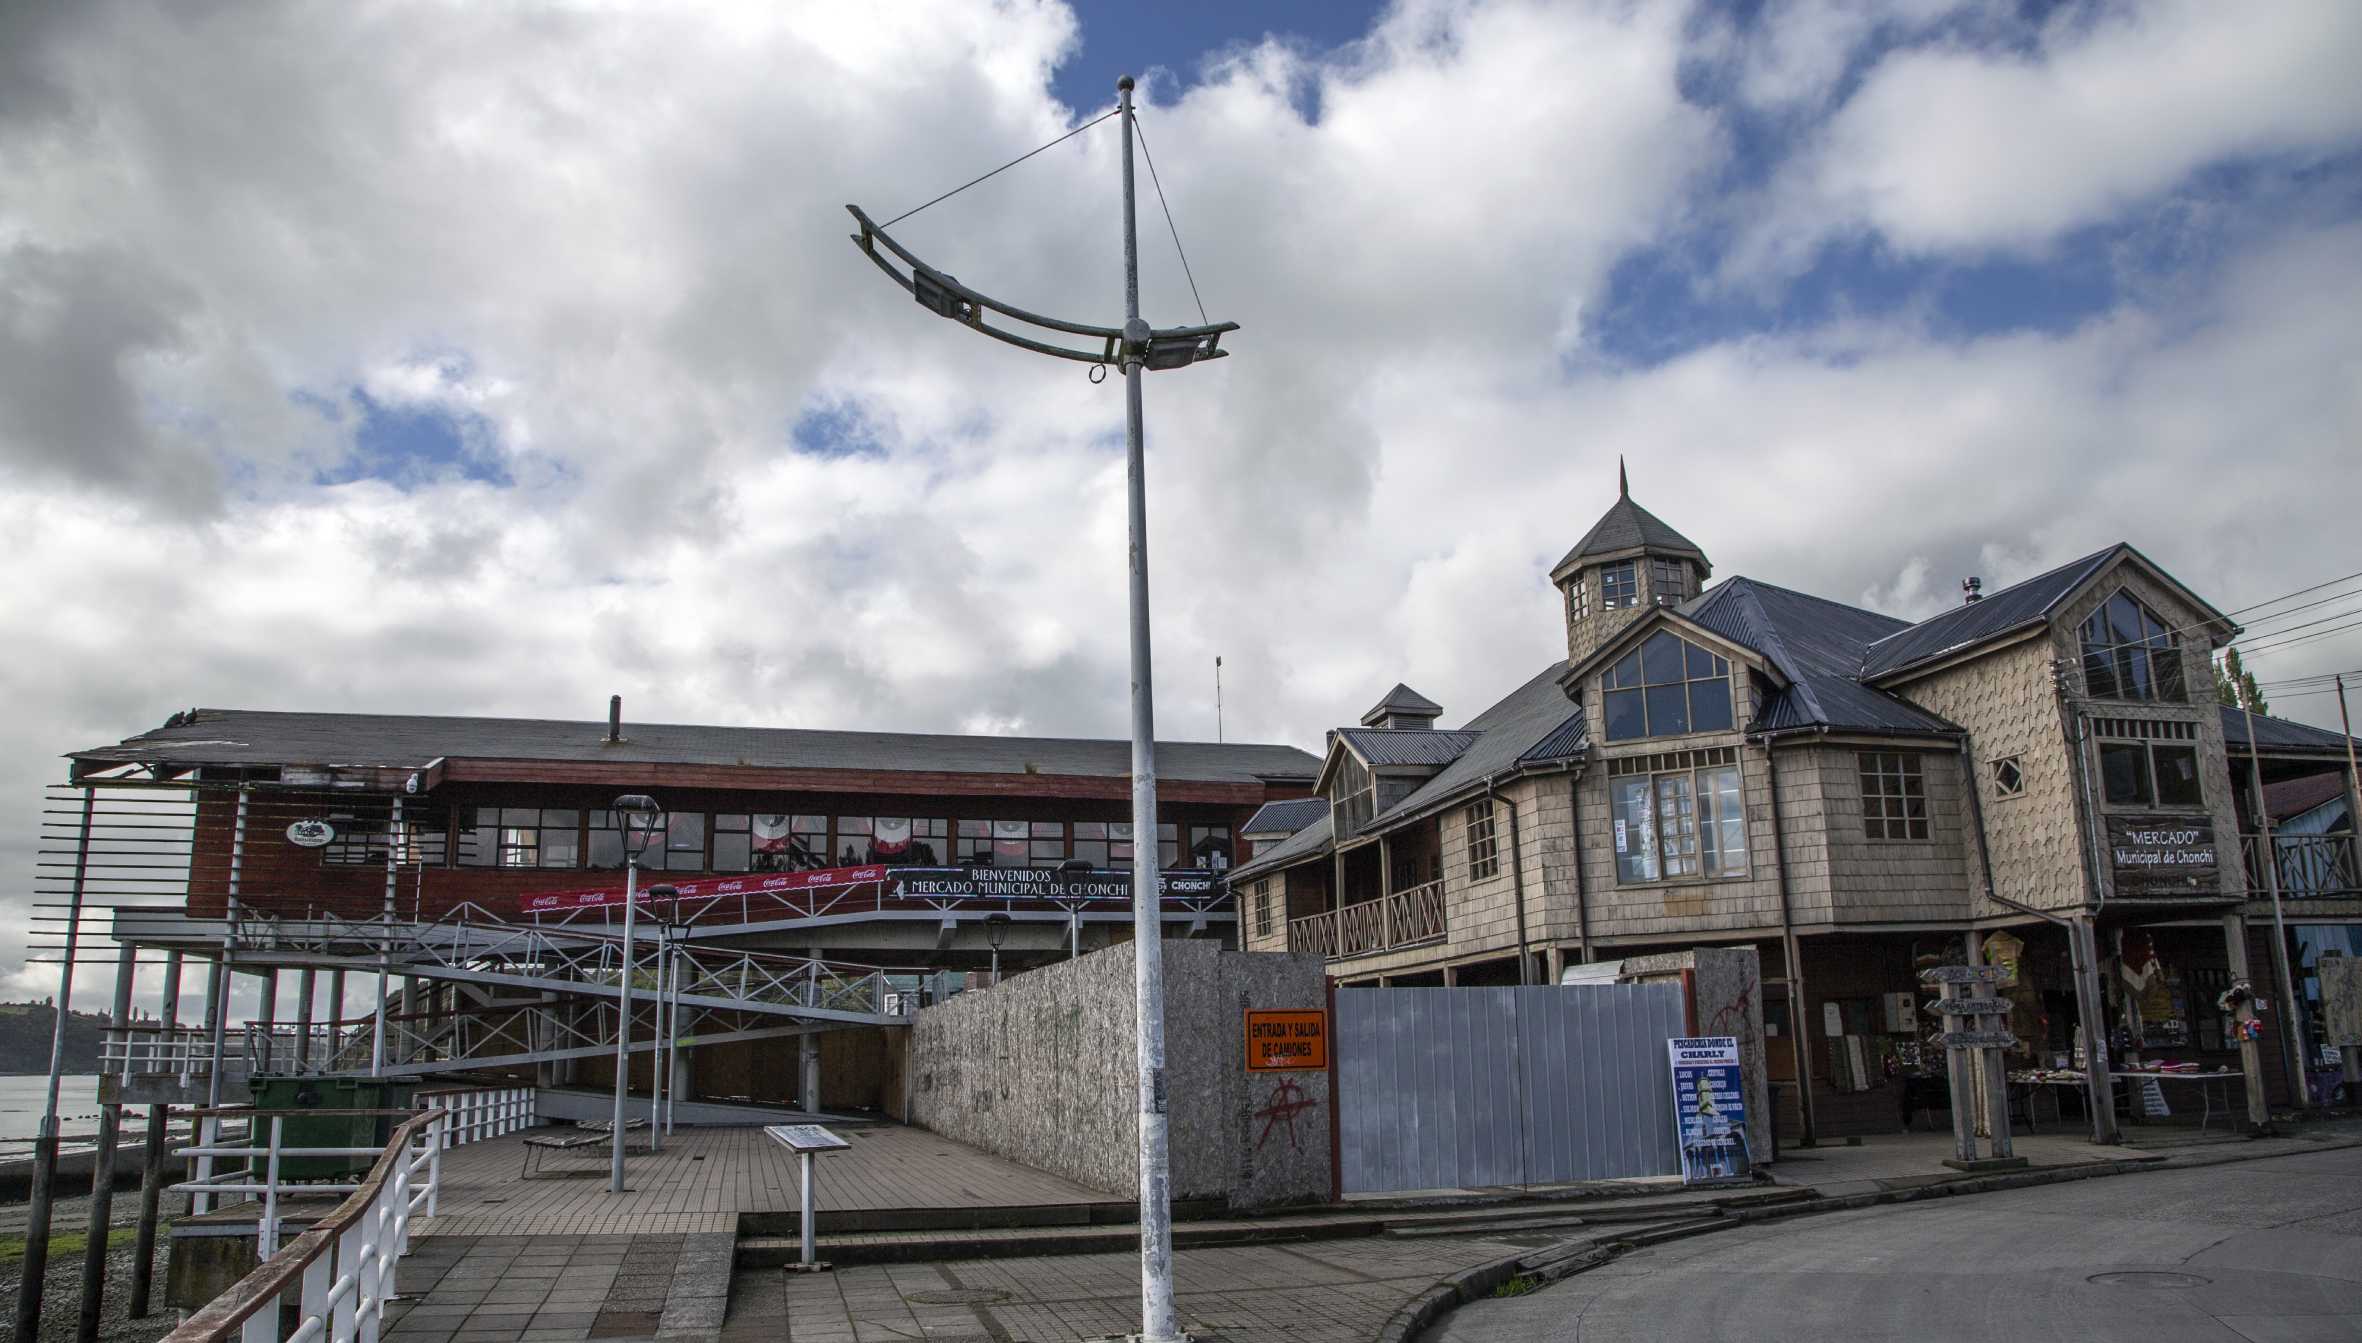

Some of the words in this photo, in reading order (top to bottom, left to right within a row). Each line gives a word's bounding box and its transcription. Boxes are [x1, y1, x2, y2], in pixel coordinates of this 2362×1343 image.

[2116, 850, 2161, 870] Municipal
[2163, 850, 2175, 864] de
[2177, 849, 2214, 863] Chonchi
[972, 869, 1051, 882] BIENVENIDOS
[912, 881, 973, 893] MERCADO
[978, 882, 1045, 895] MUNICIPAL
[1252, 1023, 1286, 1038] ENTRADA
[1288, 1023, 1293, 1037] Y
[1295, 1022, 1321, 1037] SALIDA
[1262, 1042, 1272, 1057] DE
[1273, 1042, 1312, 1056] CAMIONES
[1680, 1050, 1725, 1058] CHARLY
